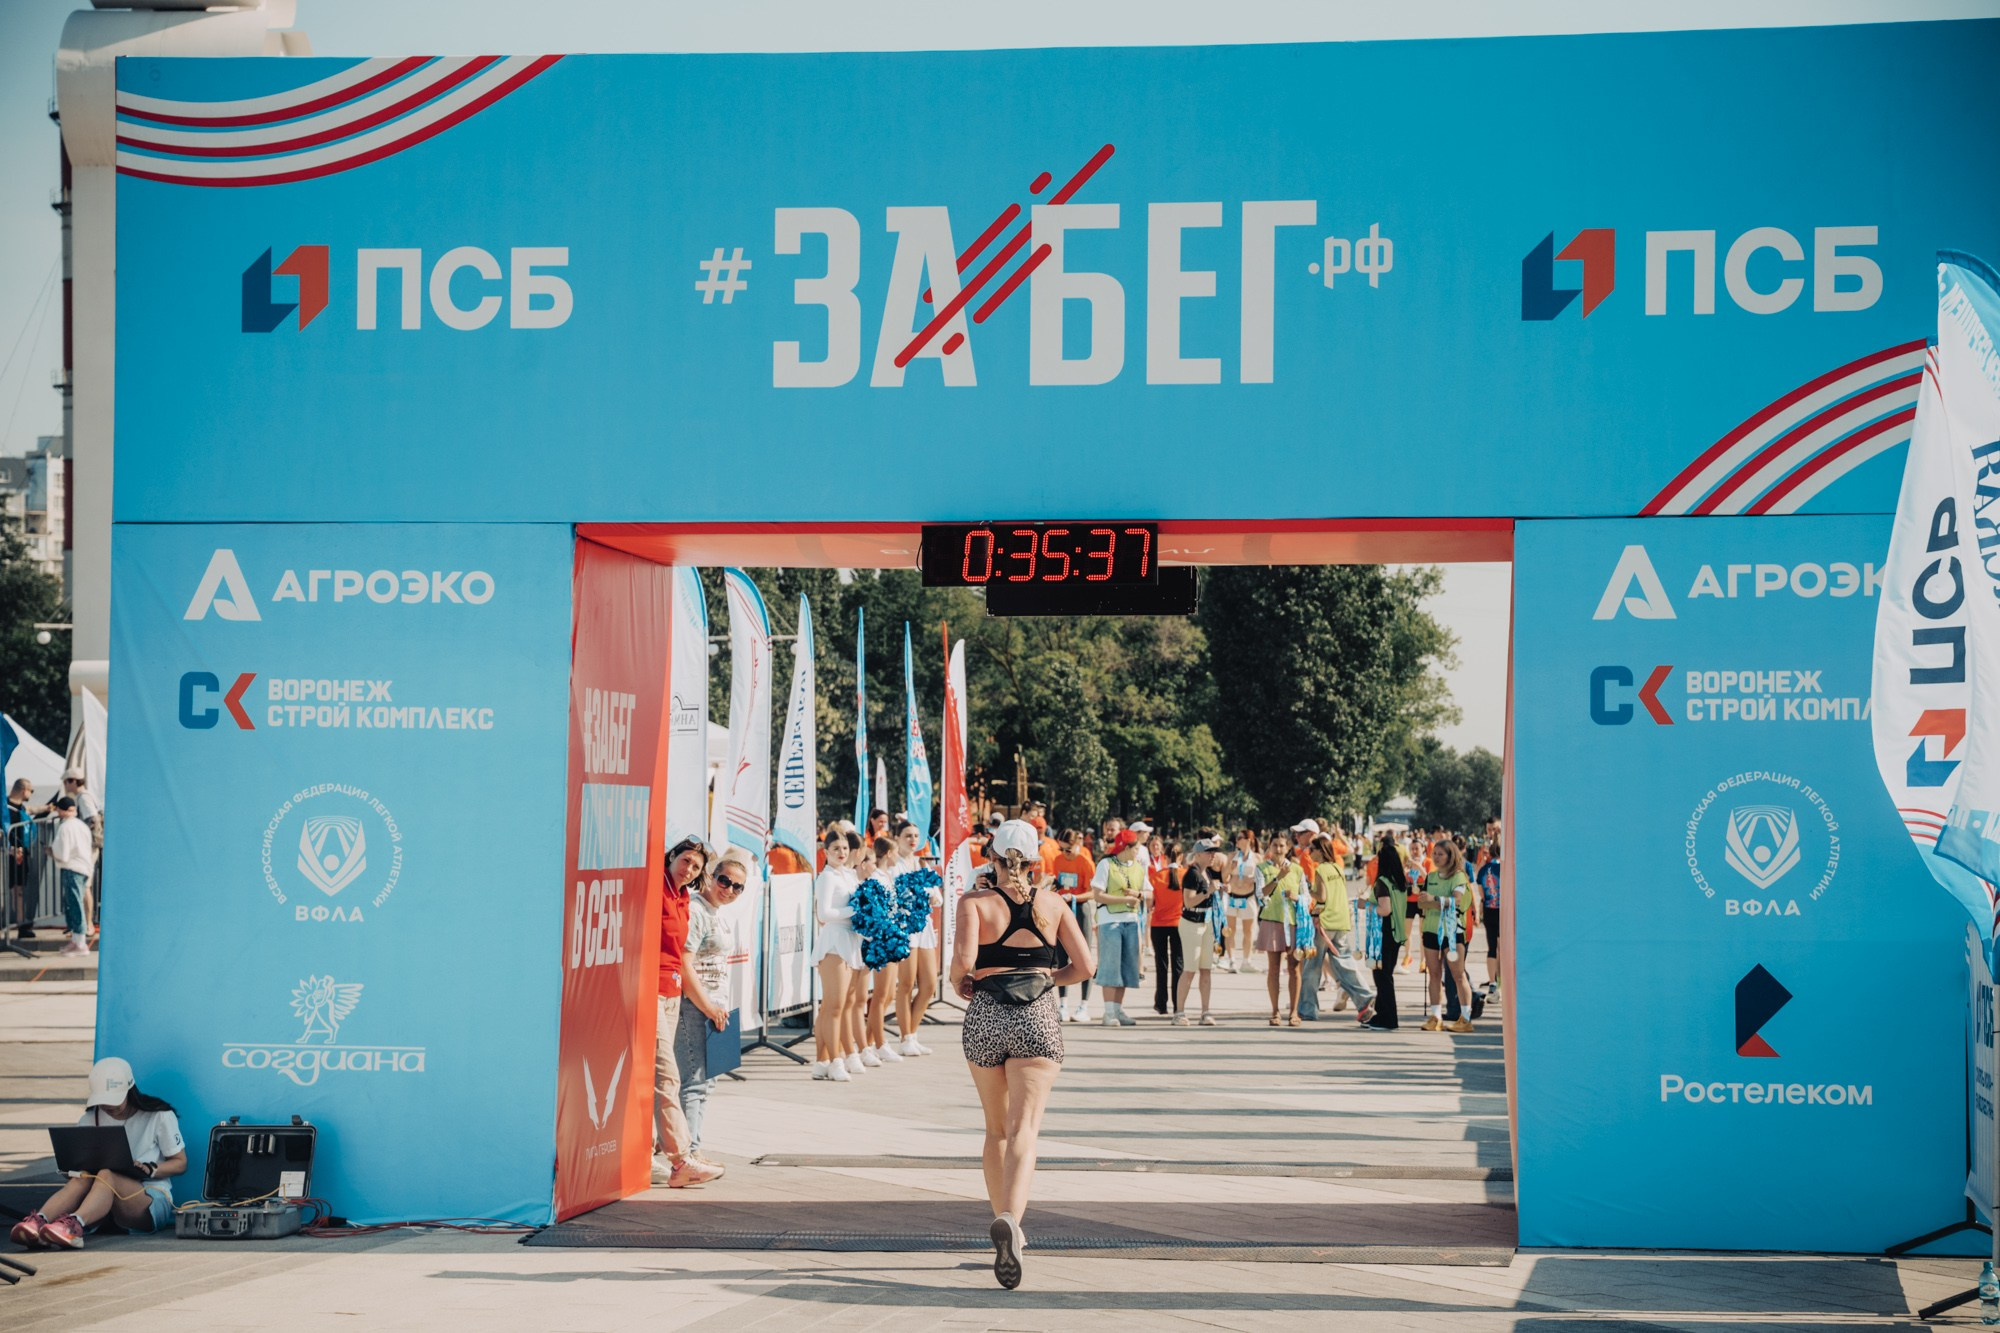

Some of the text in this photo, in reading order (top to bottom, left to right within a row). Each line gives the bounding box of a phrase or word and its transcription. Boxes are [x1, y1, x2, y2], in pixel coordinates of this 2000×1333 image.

[356, 246, 574, 331] ПСБ
[1645, 225, 1884, 316] ПСБ
[962, 528, 1151, 582] 0:35:37
[272, 569, 495, 605] АГРОЭКО
[1687, 562, 1886, 598] АГРОЭК
[267, 678, 393, 702] ВОРОНЕЖ
[1686, 670, 1823, 694] ВОРОНЕЖ
[267, 702, 494, 730] СТРОЙ КОМПЛЕКС
[1686, 694, 1873, 721] СТРОЙ КОМПЛ
[584, 687, 637, 775] #ЗАБЕГ
[624, 784, 650, 868] БЕГ
[1686, 771, 1841, 901] ВСЕРОССИЙСКАЯ ФЕДЕРАЦИЯ ЛЕГКОЙ АТЛЕТИКИ
[261, 783, 403, 908] ВСЕРОССИЙСКАЯ ФЕДЕРАЦИЯ ЛЕГКОЙ АТЛЕТИКИ
[295, 905, 364, 922] ВФЛА
[572, 878, 624, 969] В СЕБЕ
[1725, 898, 1801, 917] ВФЛА
[1661, 1074, 1873, 1105] Ростелеком
